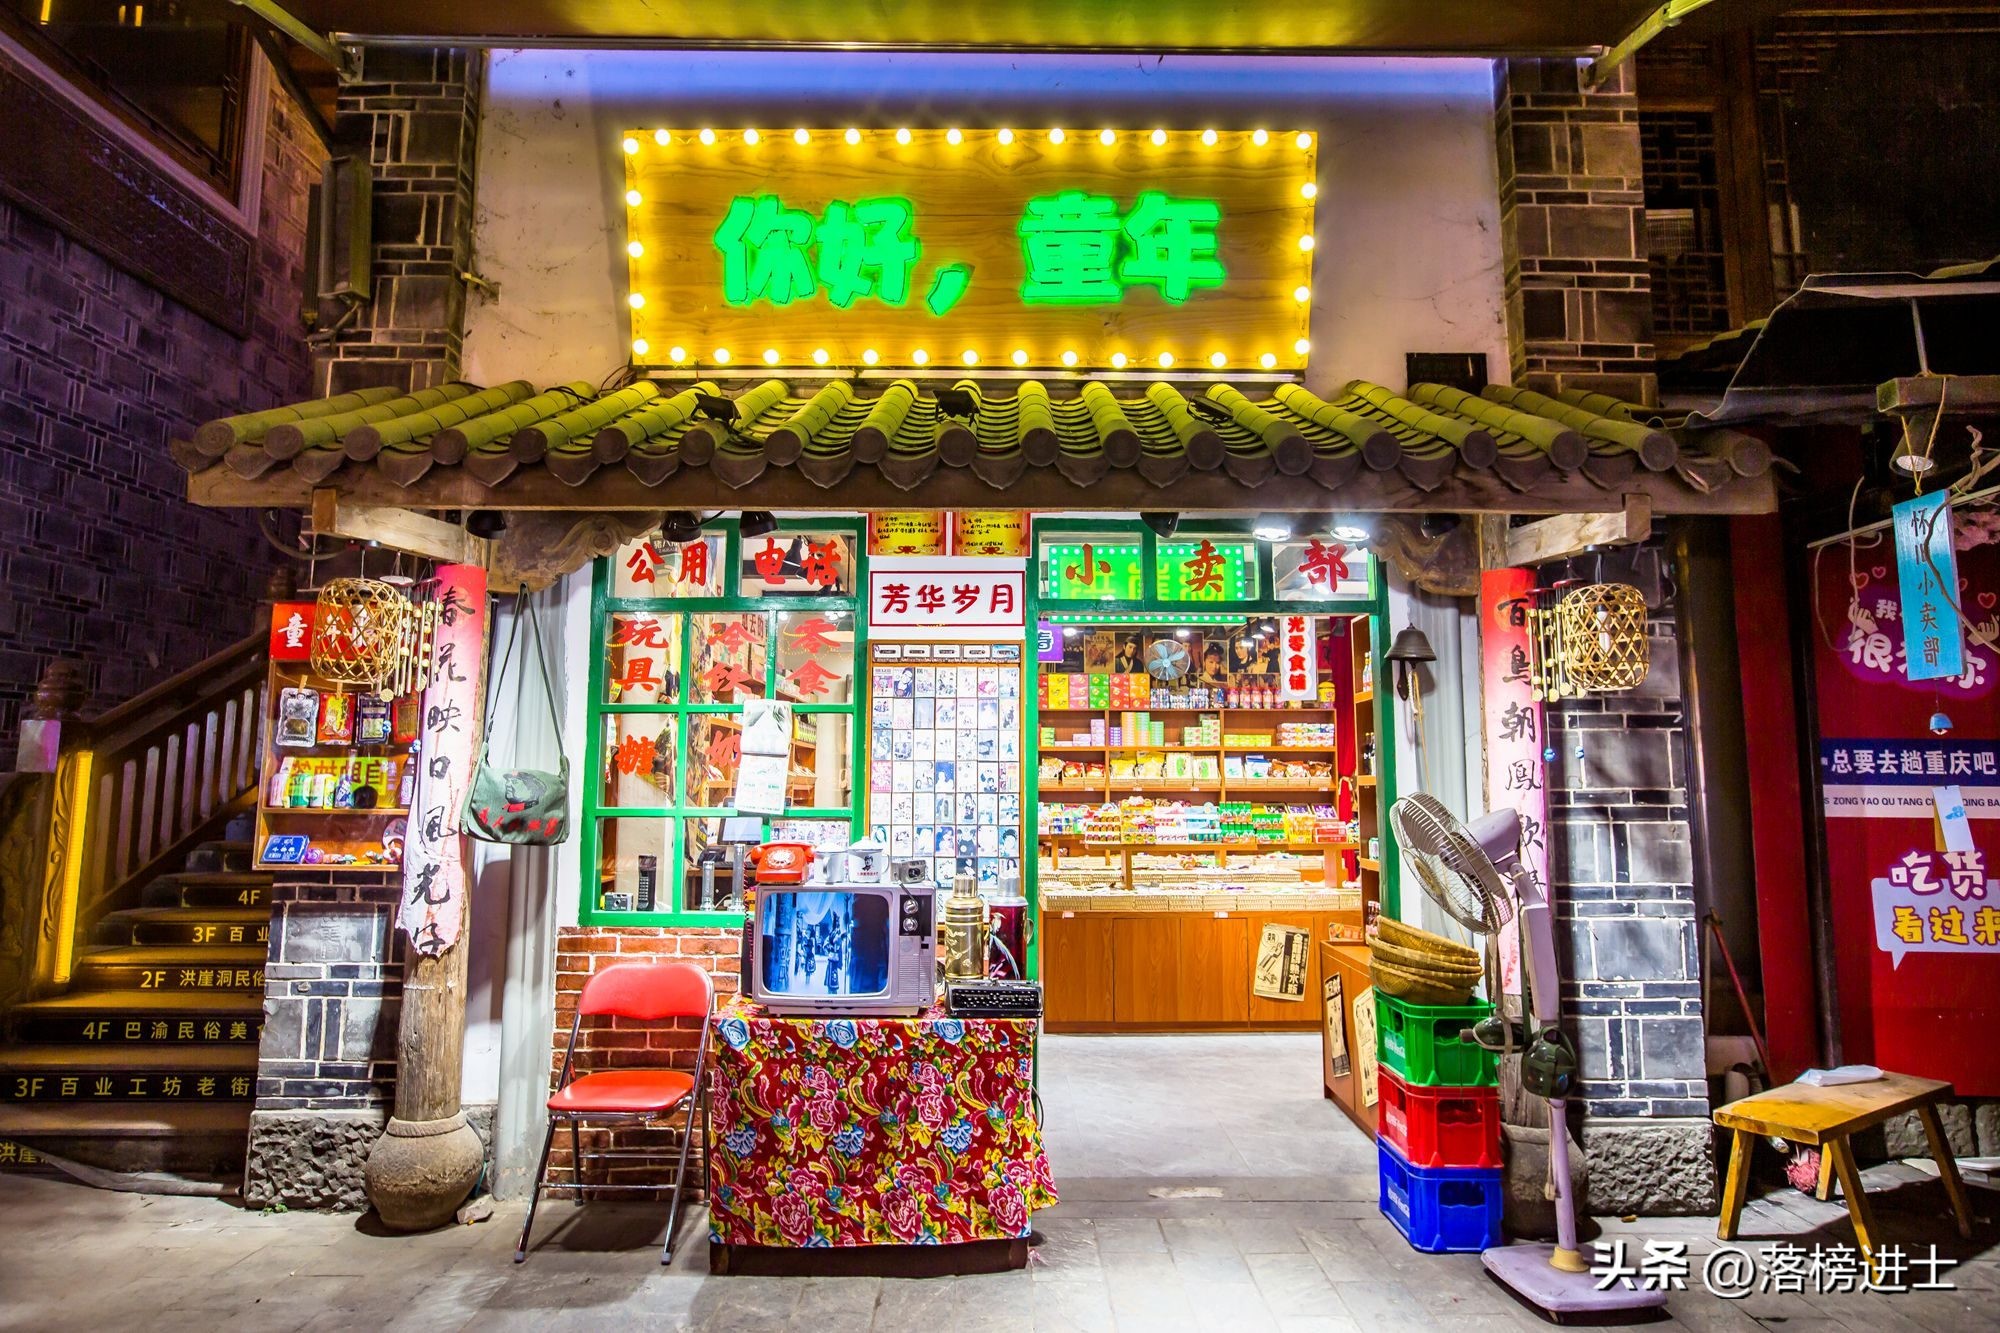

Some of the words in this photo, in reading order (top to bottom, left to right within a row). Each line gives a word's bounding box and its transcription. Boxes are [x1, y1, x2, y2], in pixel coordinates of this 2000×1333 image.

[626, 538, 842, 587] 公用电话
[1066, 539, 1349, 593] 小卖部
[881, 583, 1014, 614] 芳华岁月
[1876, 599, 1902, 621] 我
[615, 618, 669, 692] 玩具
[703, 621, 760, 694] 冷饮
[785, 618, 842, 694] 零食
[1832, 749, 1997, 775] 总要去趟重庆吧
[1833, 797, 1858, 805] ZONG
[1860, 797, 1879, 805] YAO
[1881, 798, 1895, 806] QU
[1897, 798, 1923, 806] TANG
[1891, 851, 1985, 898] 吃货
[238, 890, 261, 905] 4F
[193, 926, 216, 943] 3F
[229, 926, 270, 942] 百业
[1892, 905, 2000, 946] 看过来
[141, 970, 167, 989] 2F
[179, 970, 266, 987] 洪崖洞民俗
[83, 1021, 110, 1040] 4F
[15, 1078, 44, 1097] 3F
[60, 1076, 250, 1097] 百业工坊老街
[0, 1142, 49, 1164] 洪崖
